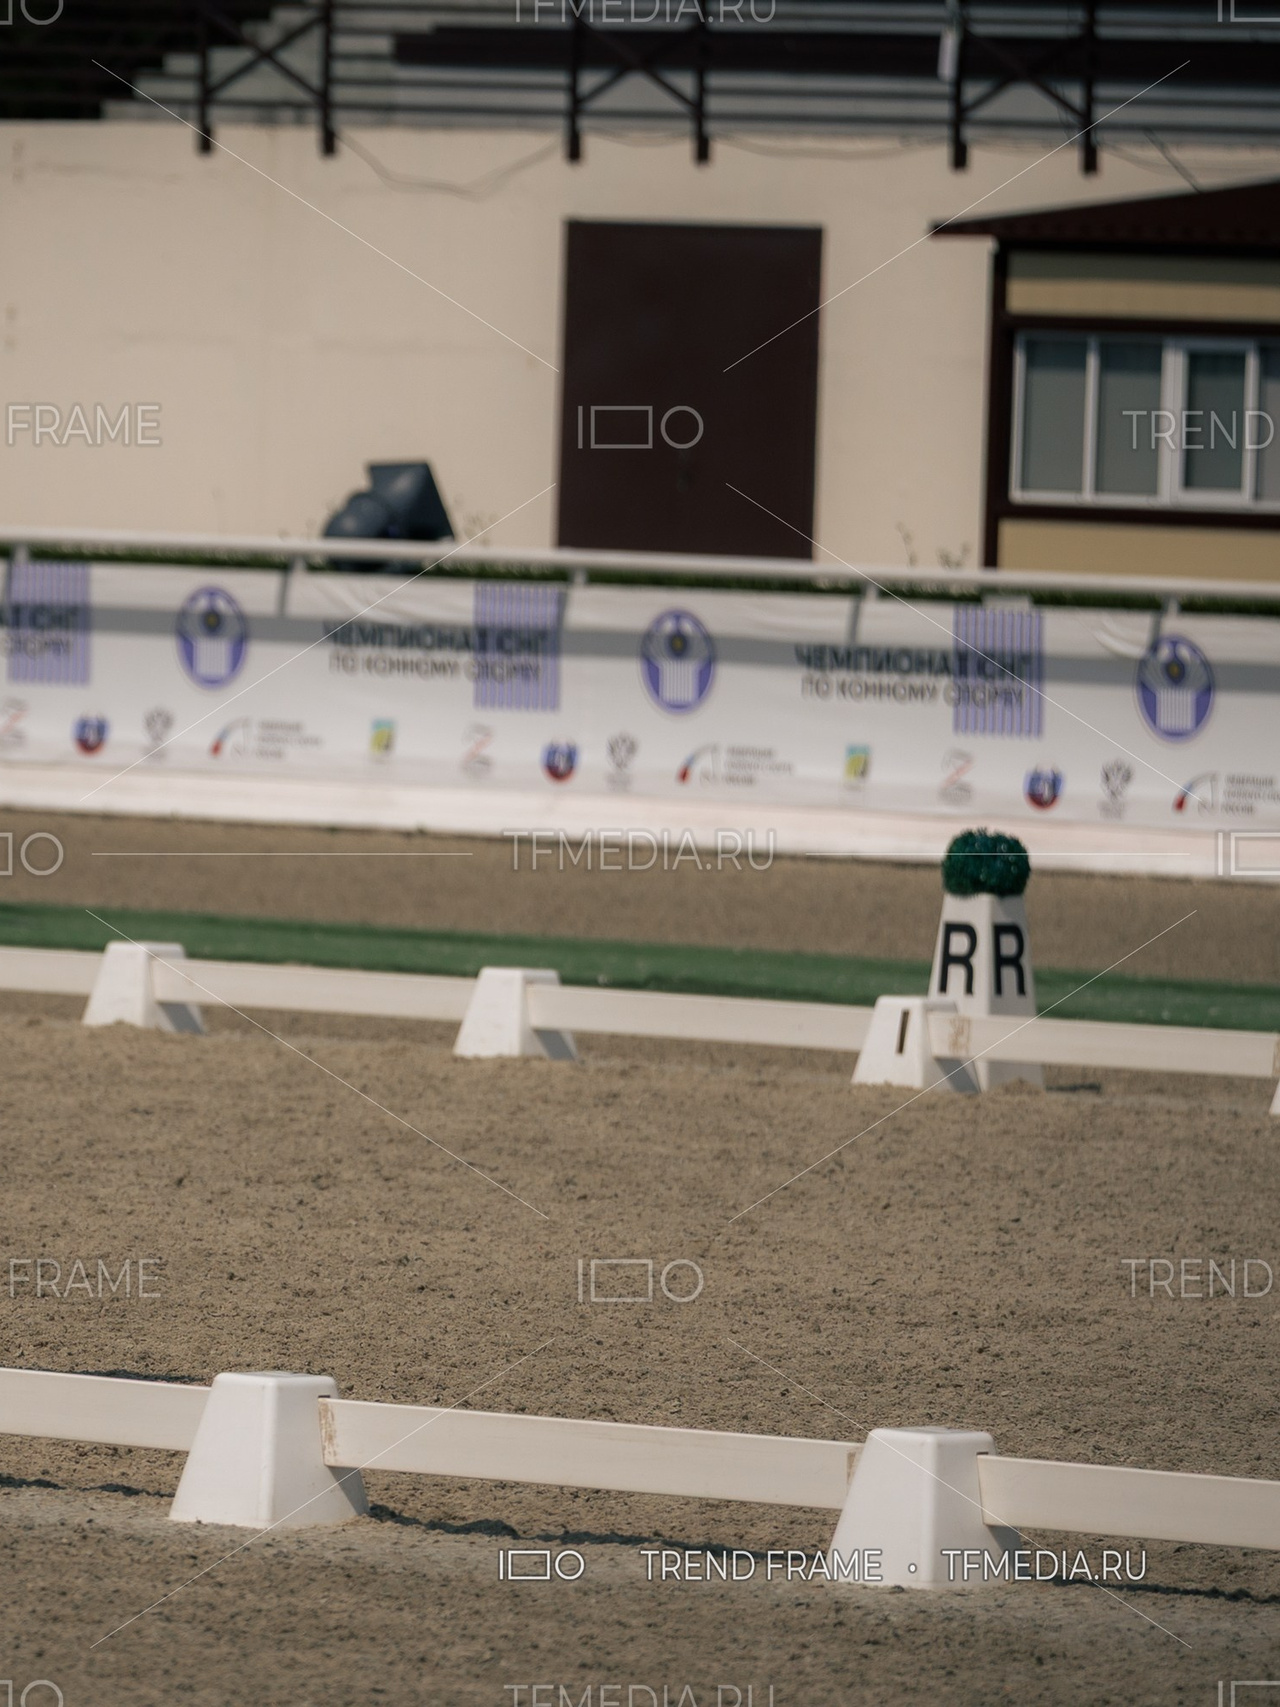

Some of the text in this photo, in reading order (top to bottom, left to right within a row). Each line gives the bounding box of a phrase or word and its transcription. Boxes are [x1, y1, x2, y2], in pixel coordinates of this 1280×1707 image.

[794, 643, 969, 678] ЧЕМПИОНАТ
[939, 920, 978, 995] R
[992, 921, 1028, 997] R
